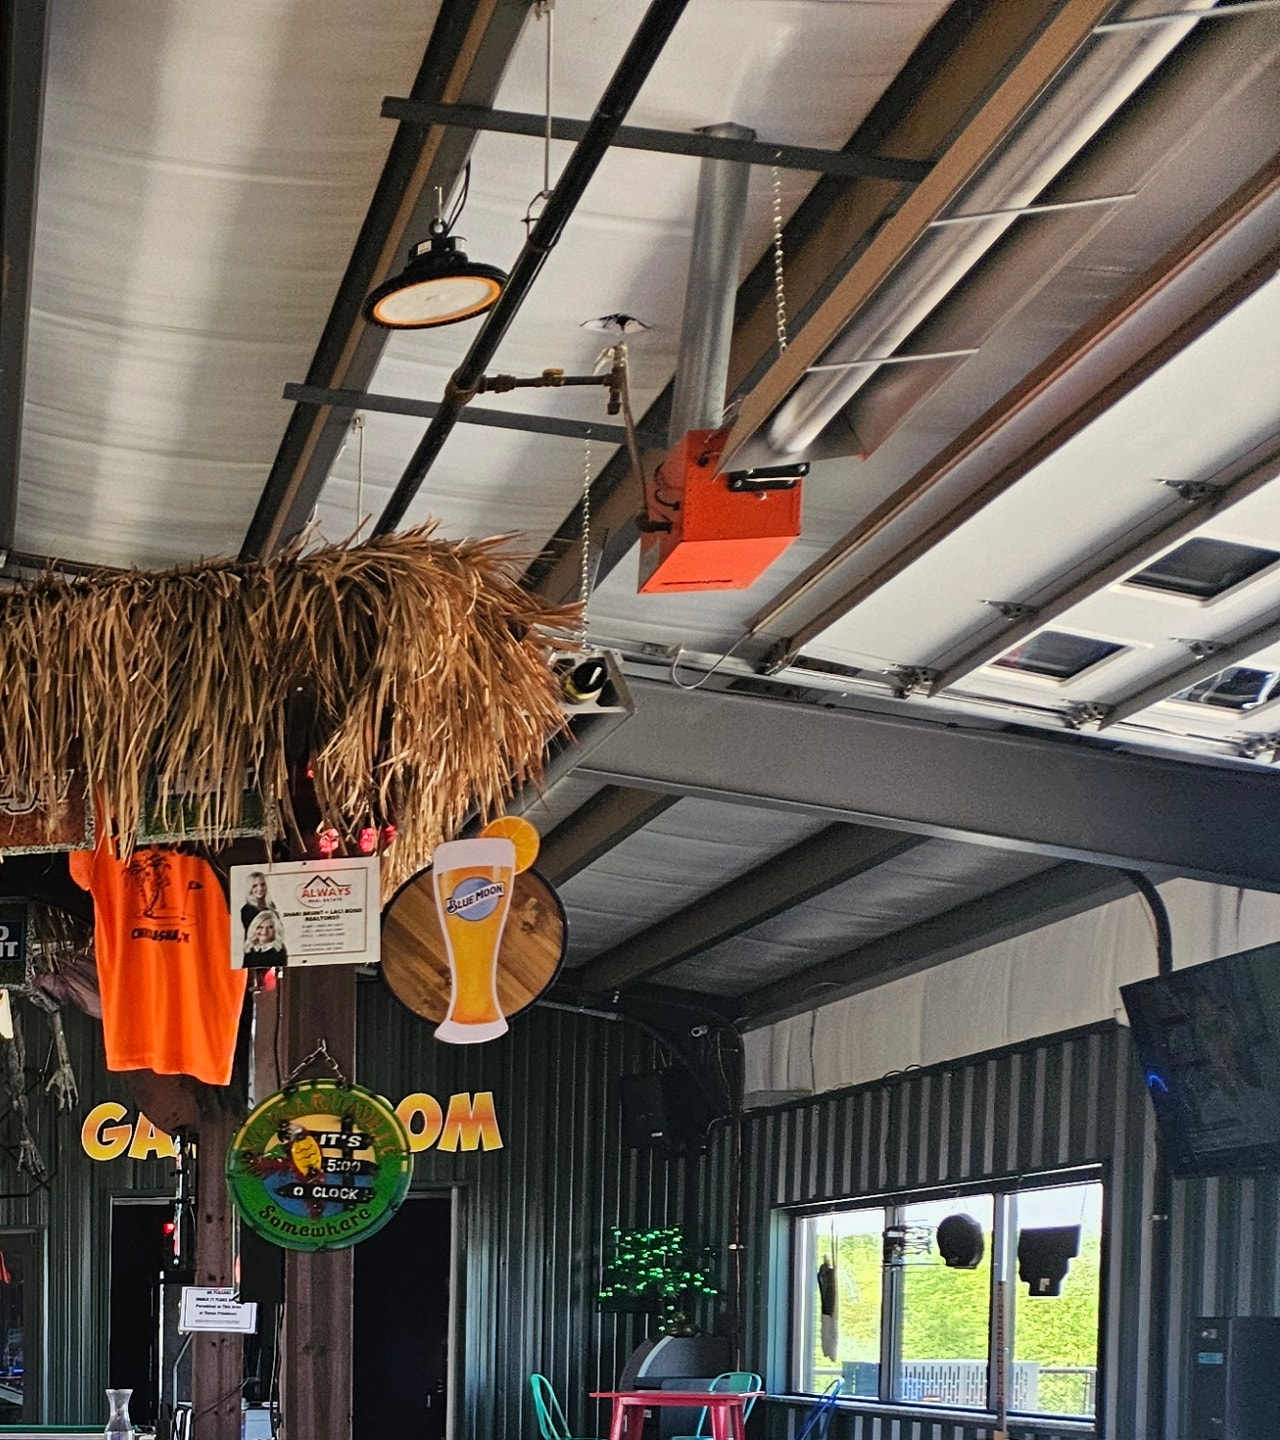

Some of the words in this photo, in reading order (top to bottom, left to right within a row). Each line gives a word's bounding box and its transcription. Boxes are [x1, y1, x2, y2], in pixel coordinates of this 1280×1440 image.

[301, 886, 352, 898] ALWAYS
[447, 894, 474, 914] BLUE
[475, 884, 503, 901] MOON
[319, 1133, 362, 1147] IT'S
[326, 1158, 361, 1172] 5:00
[312, 1186, 359, 1200] CLOCK
[258, 1204, 372, 1237] Somewhere
